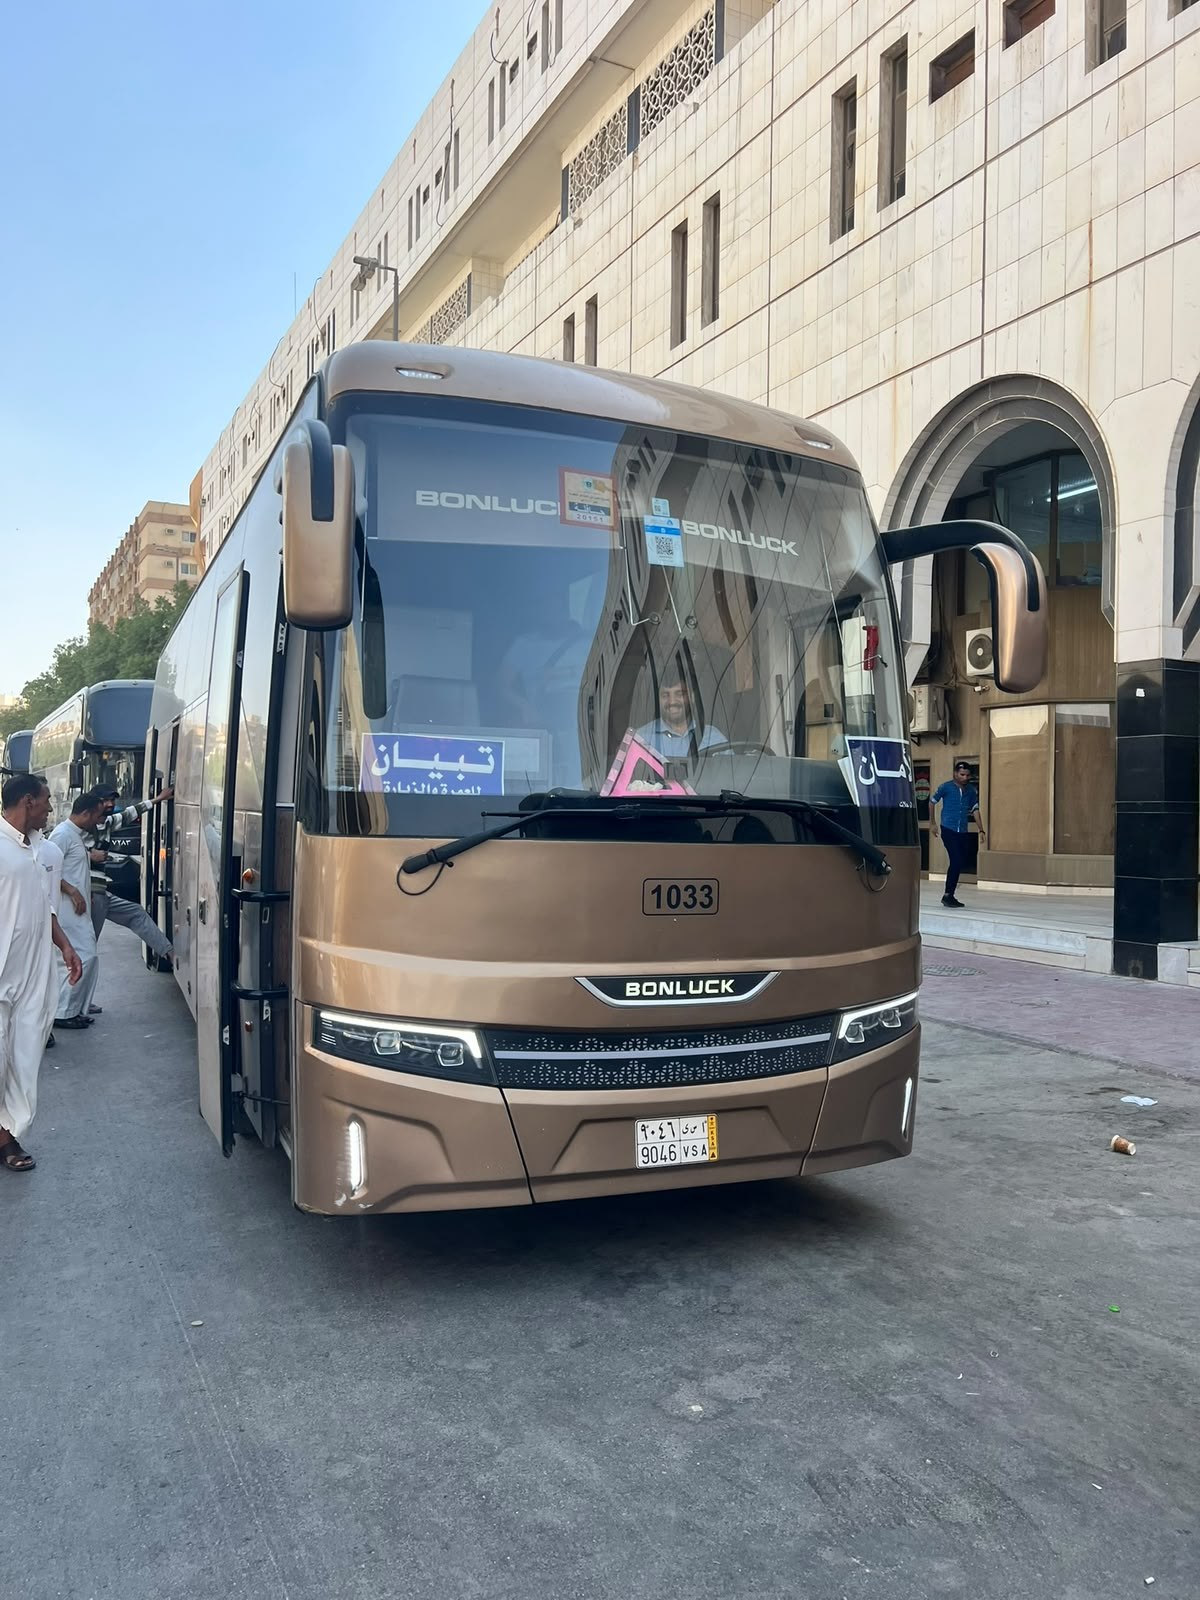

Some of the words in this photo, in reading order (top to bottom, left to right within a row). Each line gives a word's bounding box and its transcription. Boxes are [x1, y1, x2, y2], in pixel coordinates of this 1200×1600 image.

[415, 489, 560, 516] BONLUC
[681, 519, 799, 557] BONLUCK
[371, 741, 495, 781] تبيان
[651, 884, 714, 910] 1033
[625, 979, 735, 997] BONLUCK
[641, 1144, 677, 1165] 9046
